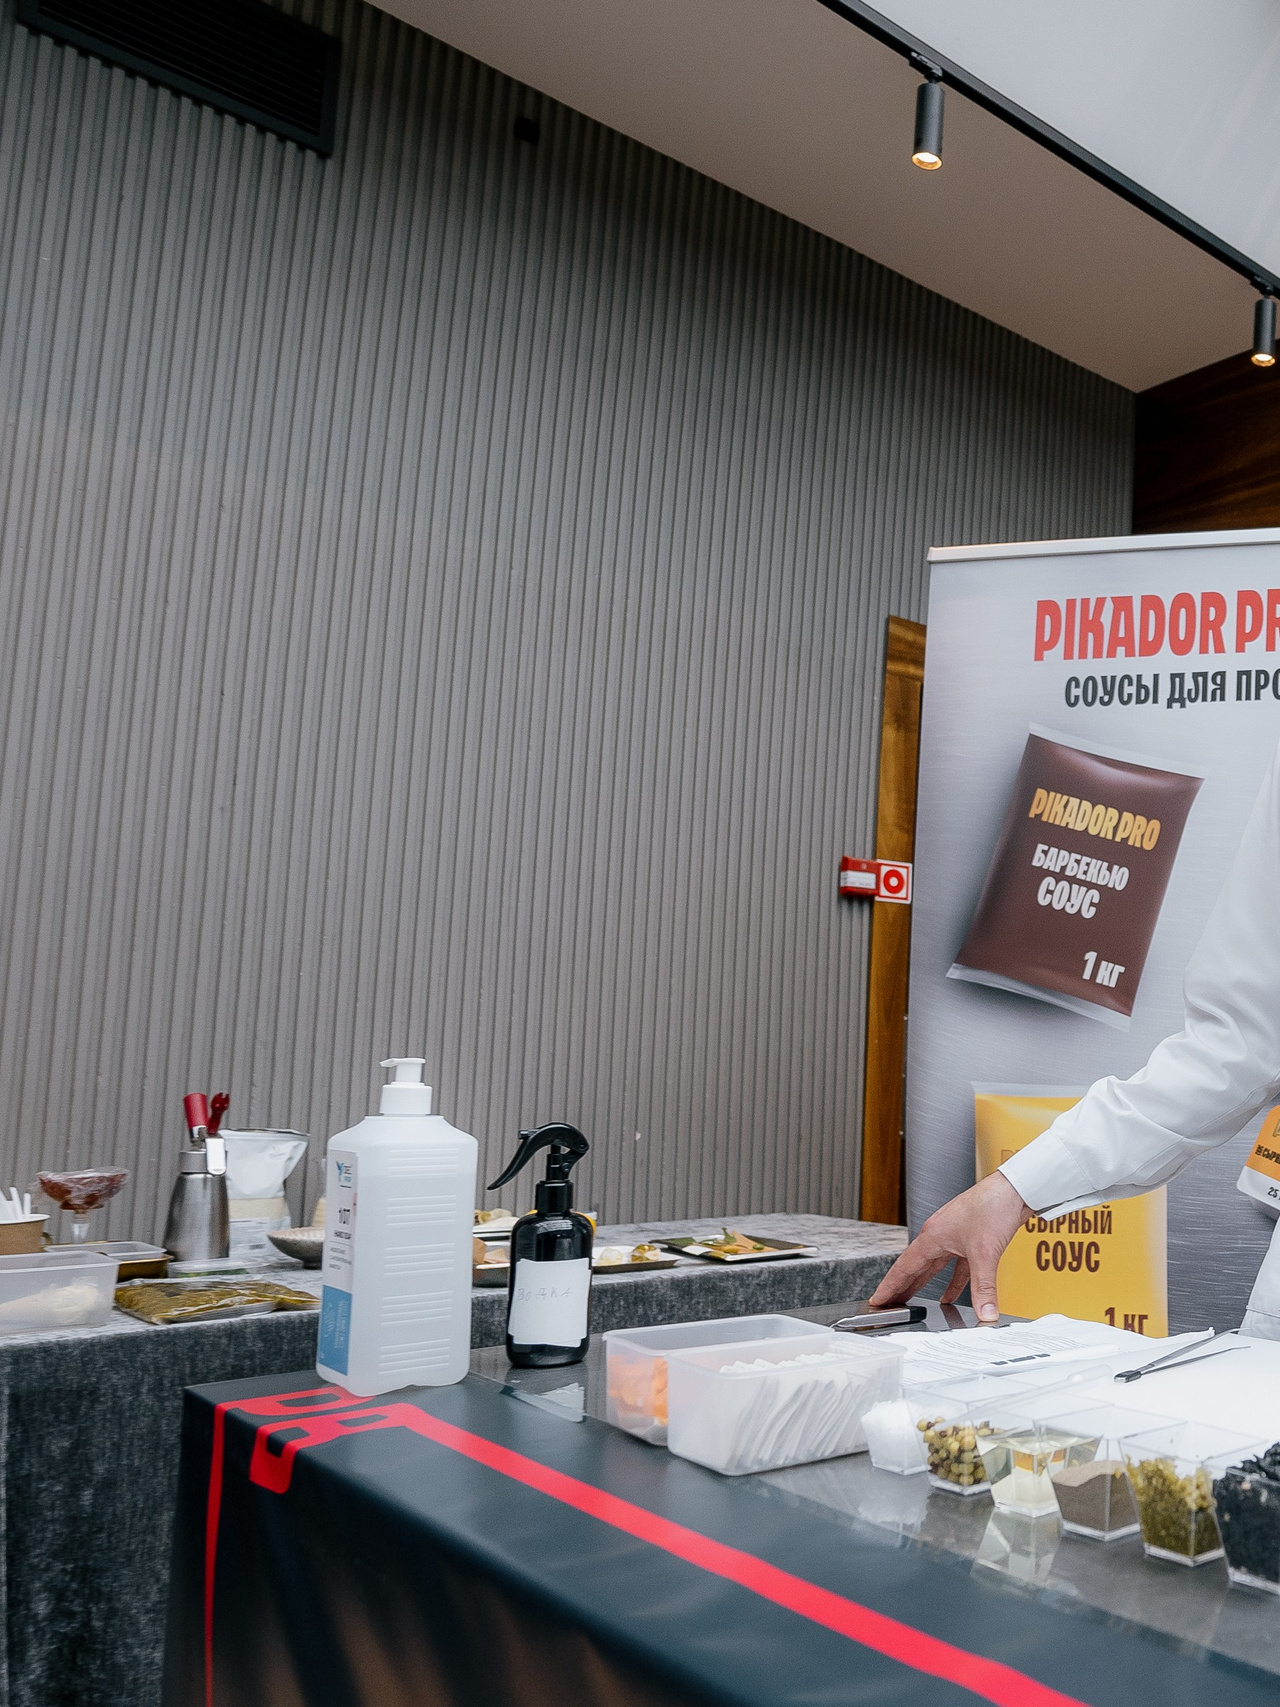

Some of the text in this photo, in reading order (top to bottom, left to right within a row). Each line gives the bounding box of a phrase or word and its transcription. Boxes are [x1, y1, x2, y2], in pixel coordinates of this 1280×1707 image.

[1033, 591, 1227, 662] PIKADOR
[1065, 672, 1160, 708] СОУСЫ
[1166, 670, 1226, 709] ДЛЯ
[1028, 787, 1161, 851] PIKADOR PRO
[1037, 876, 1101, 919] СОУС
[1082, 951, 1098, 980] 1
[1267, 1186, 1280, 1198] 25
[1025, 1205, 1113, 1235] СЫРНЫЙ
[1036, 1240, 1100, 1273] СОУС
[1104, 1307, 1116, 1327] 1
